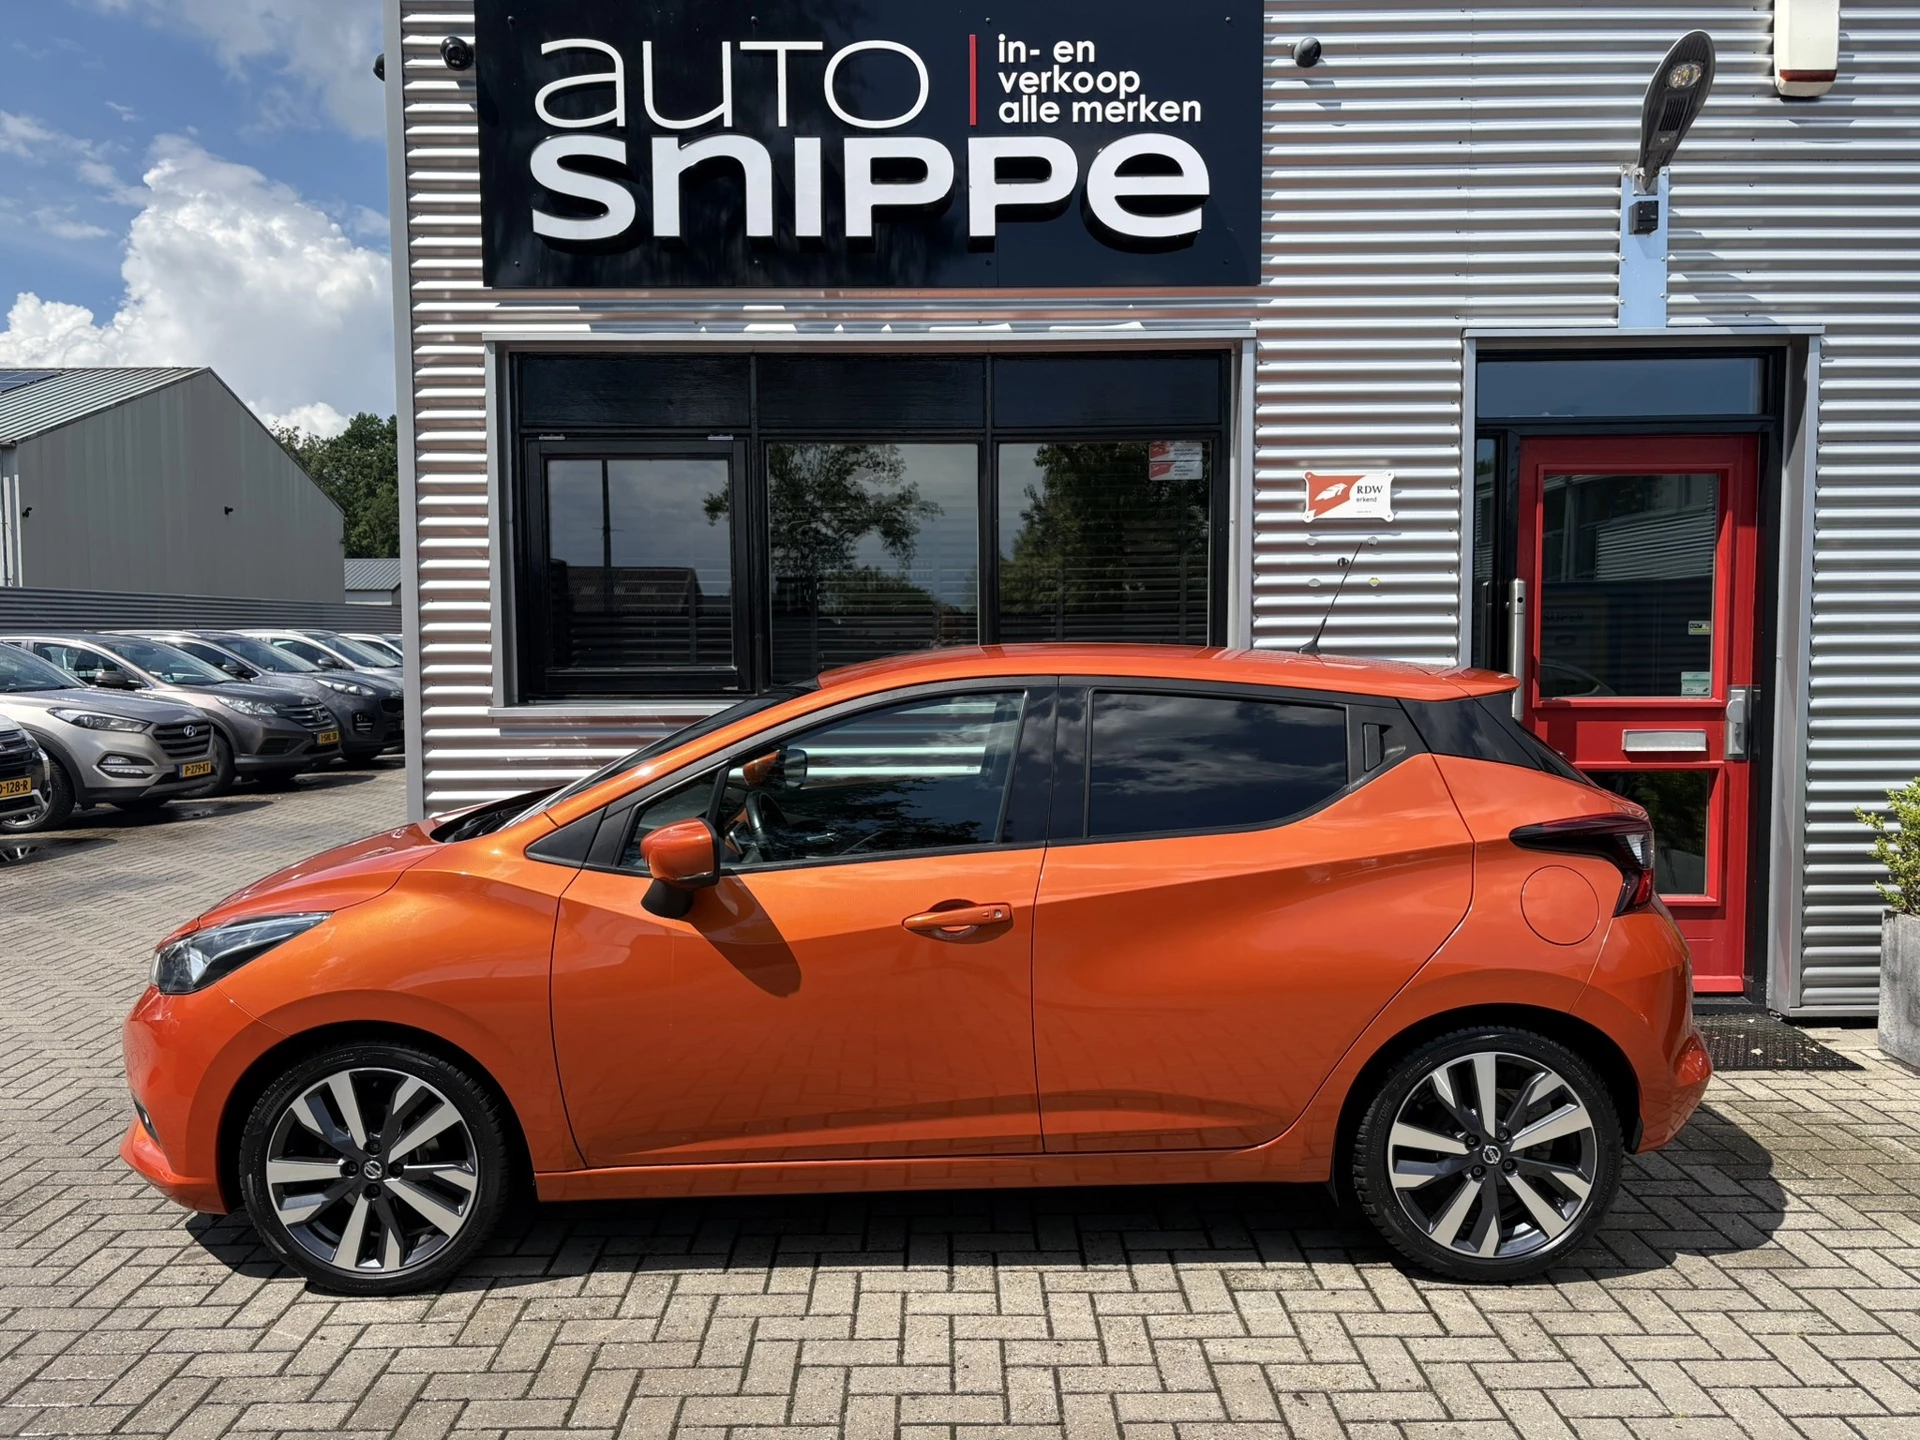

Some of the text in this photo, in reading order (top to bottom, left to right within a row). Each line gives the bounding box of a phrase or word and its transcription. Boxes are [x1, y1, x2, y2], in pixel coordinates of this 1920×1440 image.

[998, 34, 1095, 64] in- en
[997, 65, 1142, 101] verkoop
[998, 95, 1202, 124] alle merken
[1356, 485, 1384, 495] RDW
